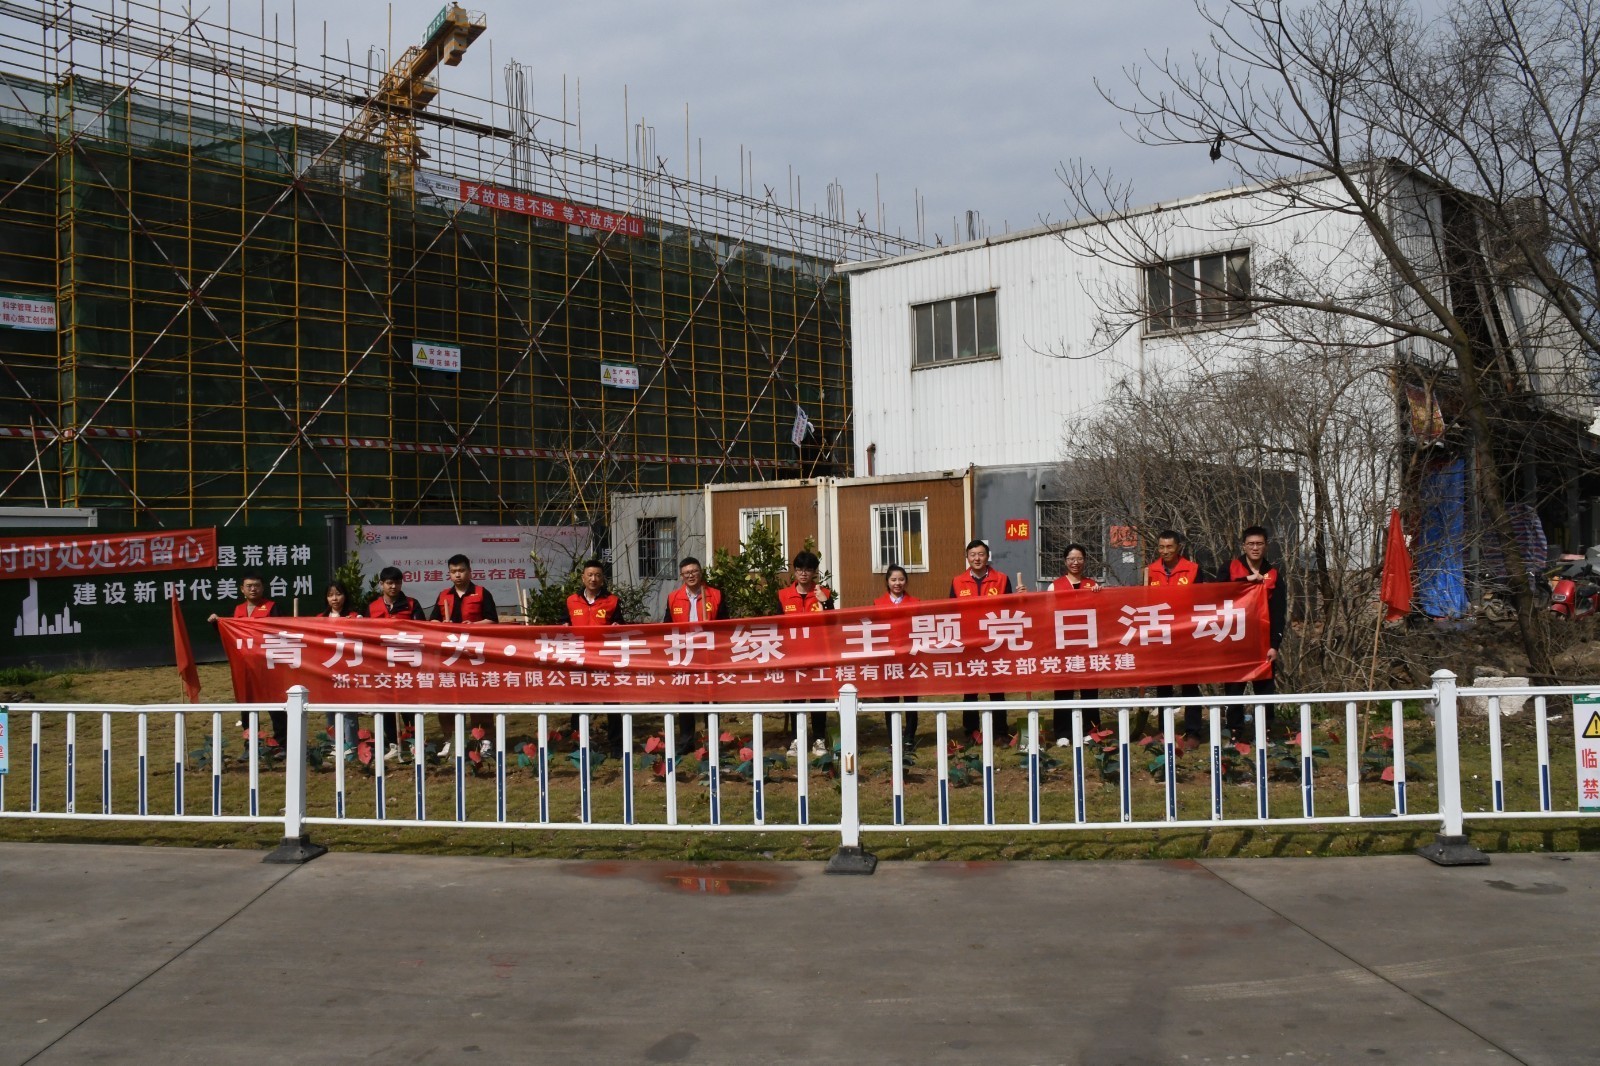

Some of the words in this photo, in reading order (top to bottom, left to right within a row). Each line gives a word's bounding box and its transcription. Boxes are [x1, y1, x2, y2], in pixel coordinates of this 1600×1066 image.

[467, 185, 555, 217] 事故隐患不除
[562, 205, 639, 234] 等于放虎归山
[1007, 523, 1028, 537] 小店
[217, 544, 311, 567] 垦荒精神
[73, 575, 313, 606] 建设新时代美台州
[841, 599, 1247, 660] 主题党日活动
[1581, 748, 1598, 769] 临
[1583, 778, 1599, 800] 禁
